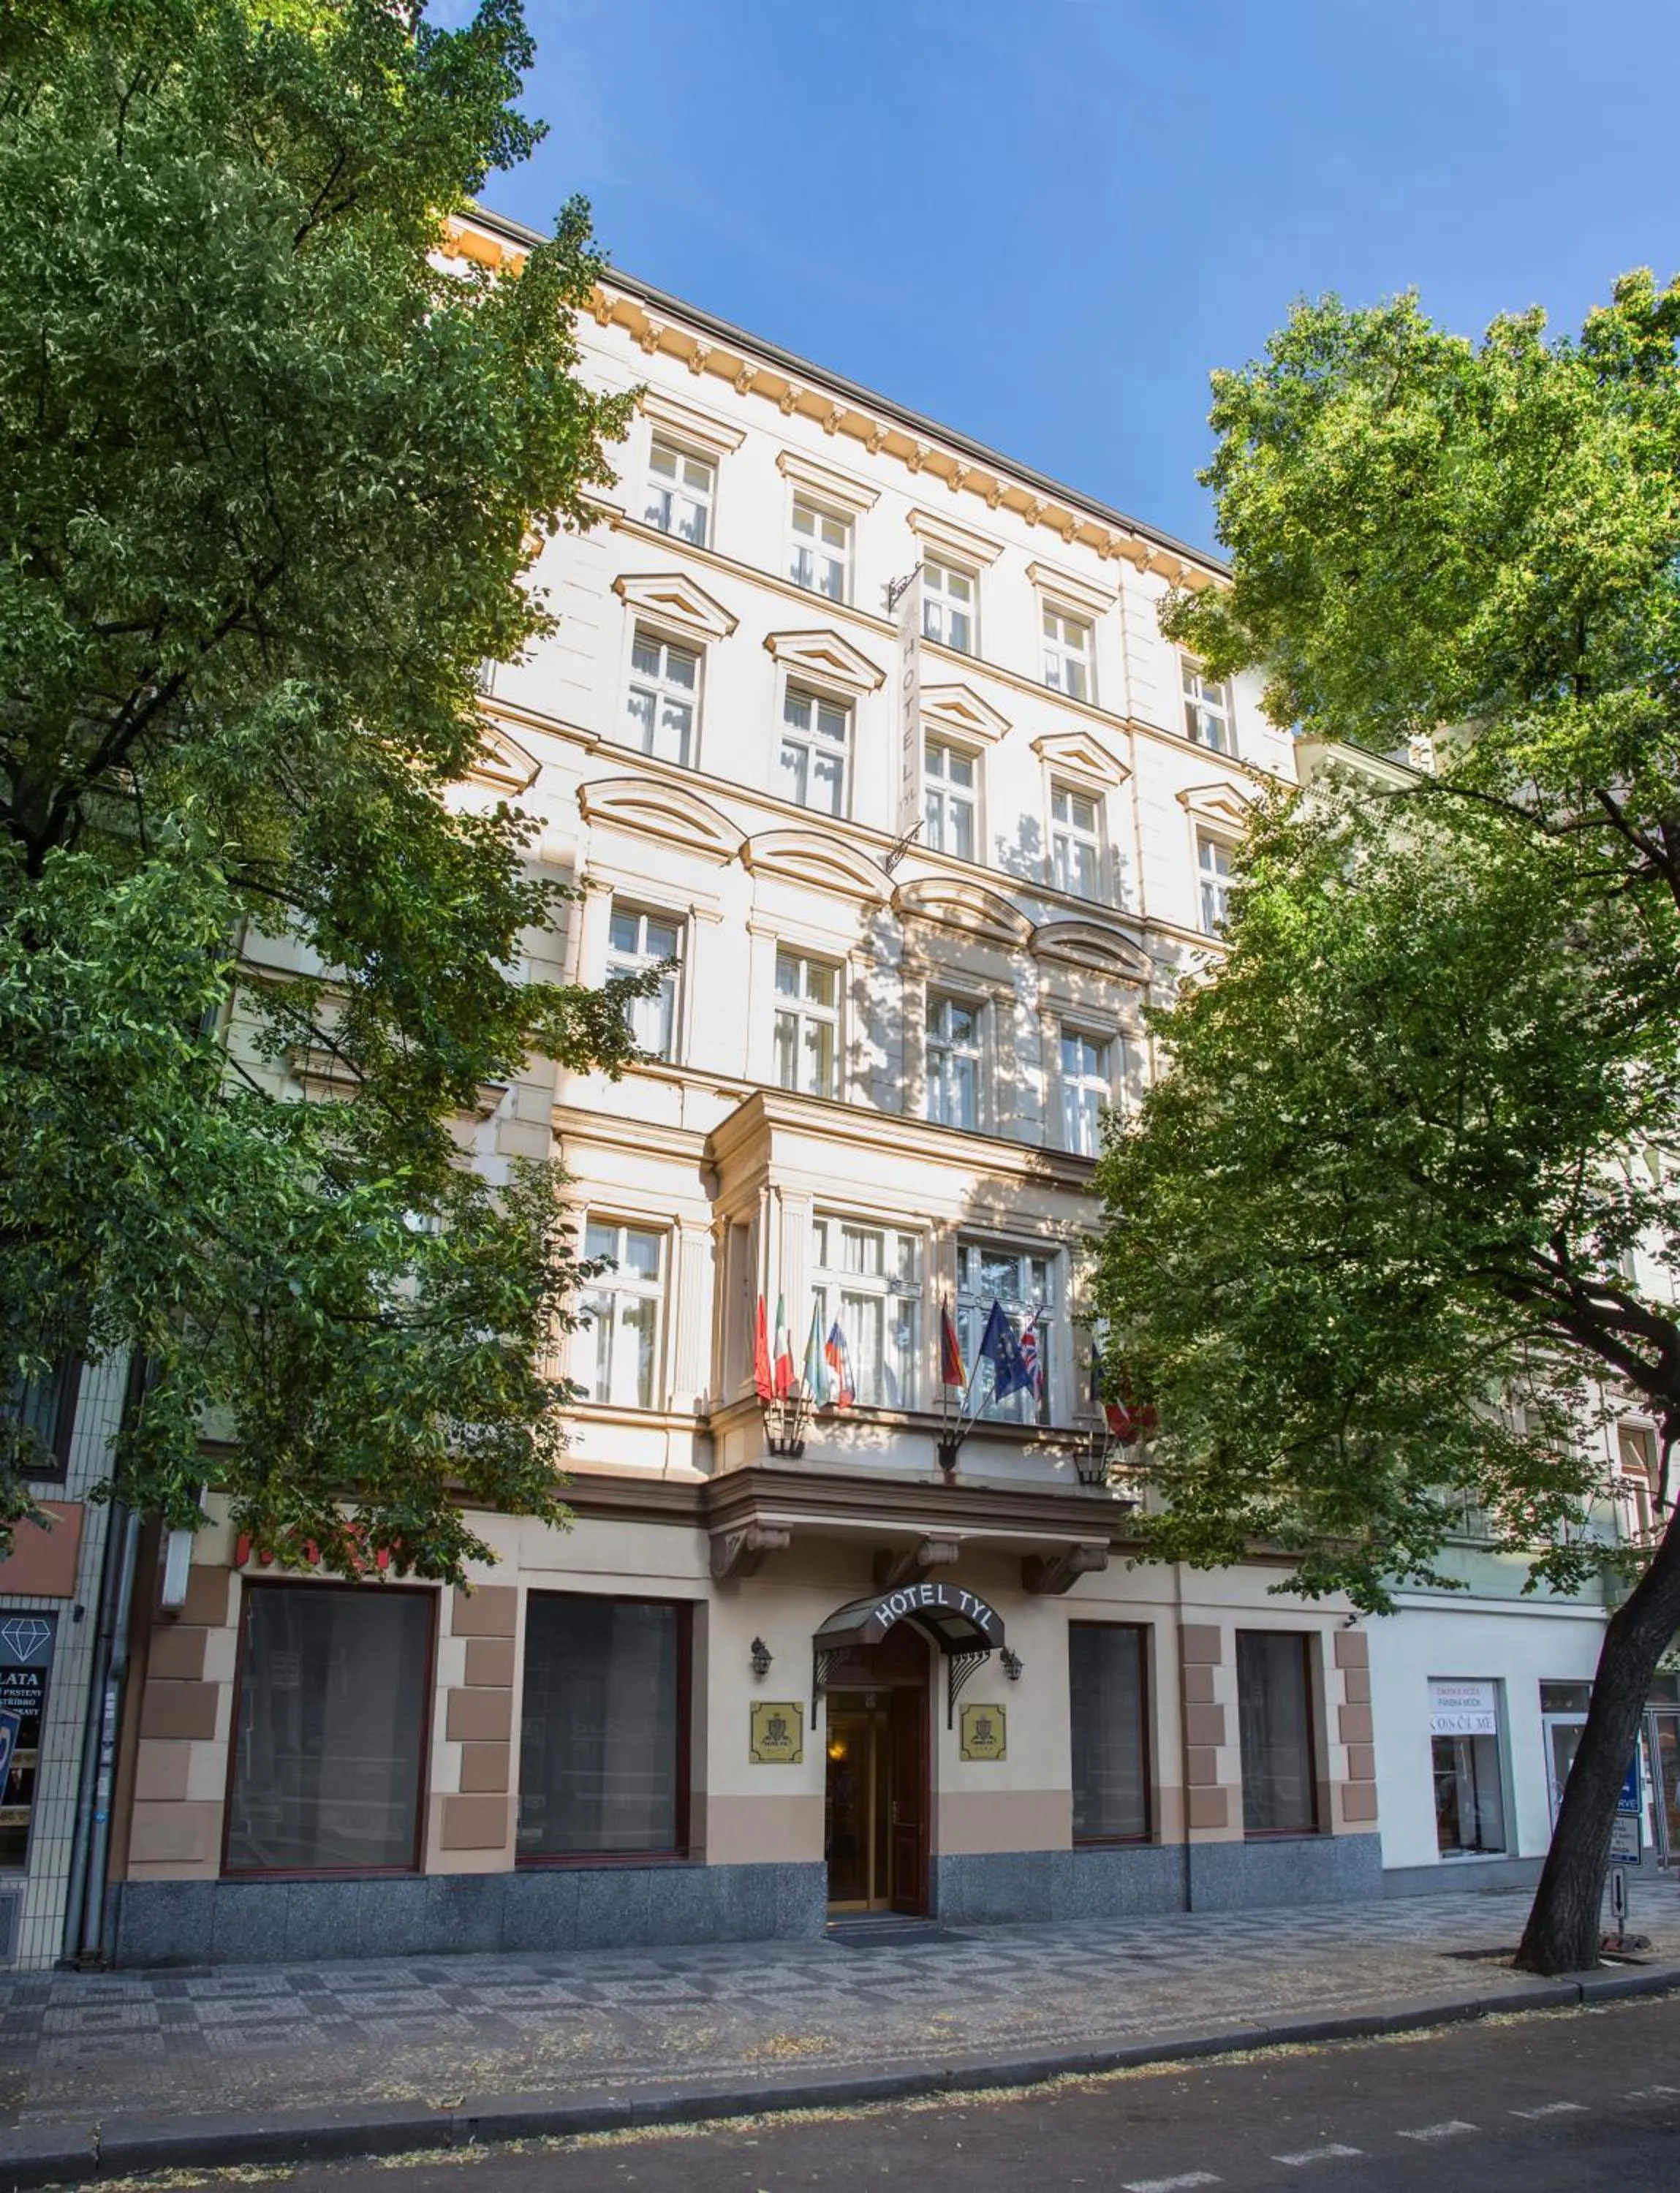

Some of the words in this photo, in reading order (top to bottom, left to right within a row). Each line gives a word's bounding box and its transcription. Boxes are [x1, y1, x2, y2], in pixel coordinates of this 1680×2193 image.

[902, 638, 915, 783] HOTEL
[898, 789, 917, 811] TYL
[875, 1584, 948, 1627] HOTEL
[960, 1590, 992, 1631] TYL
